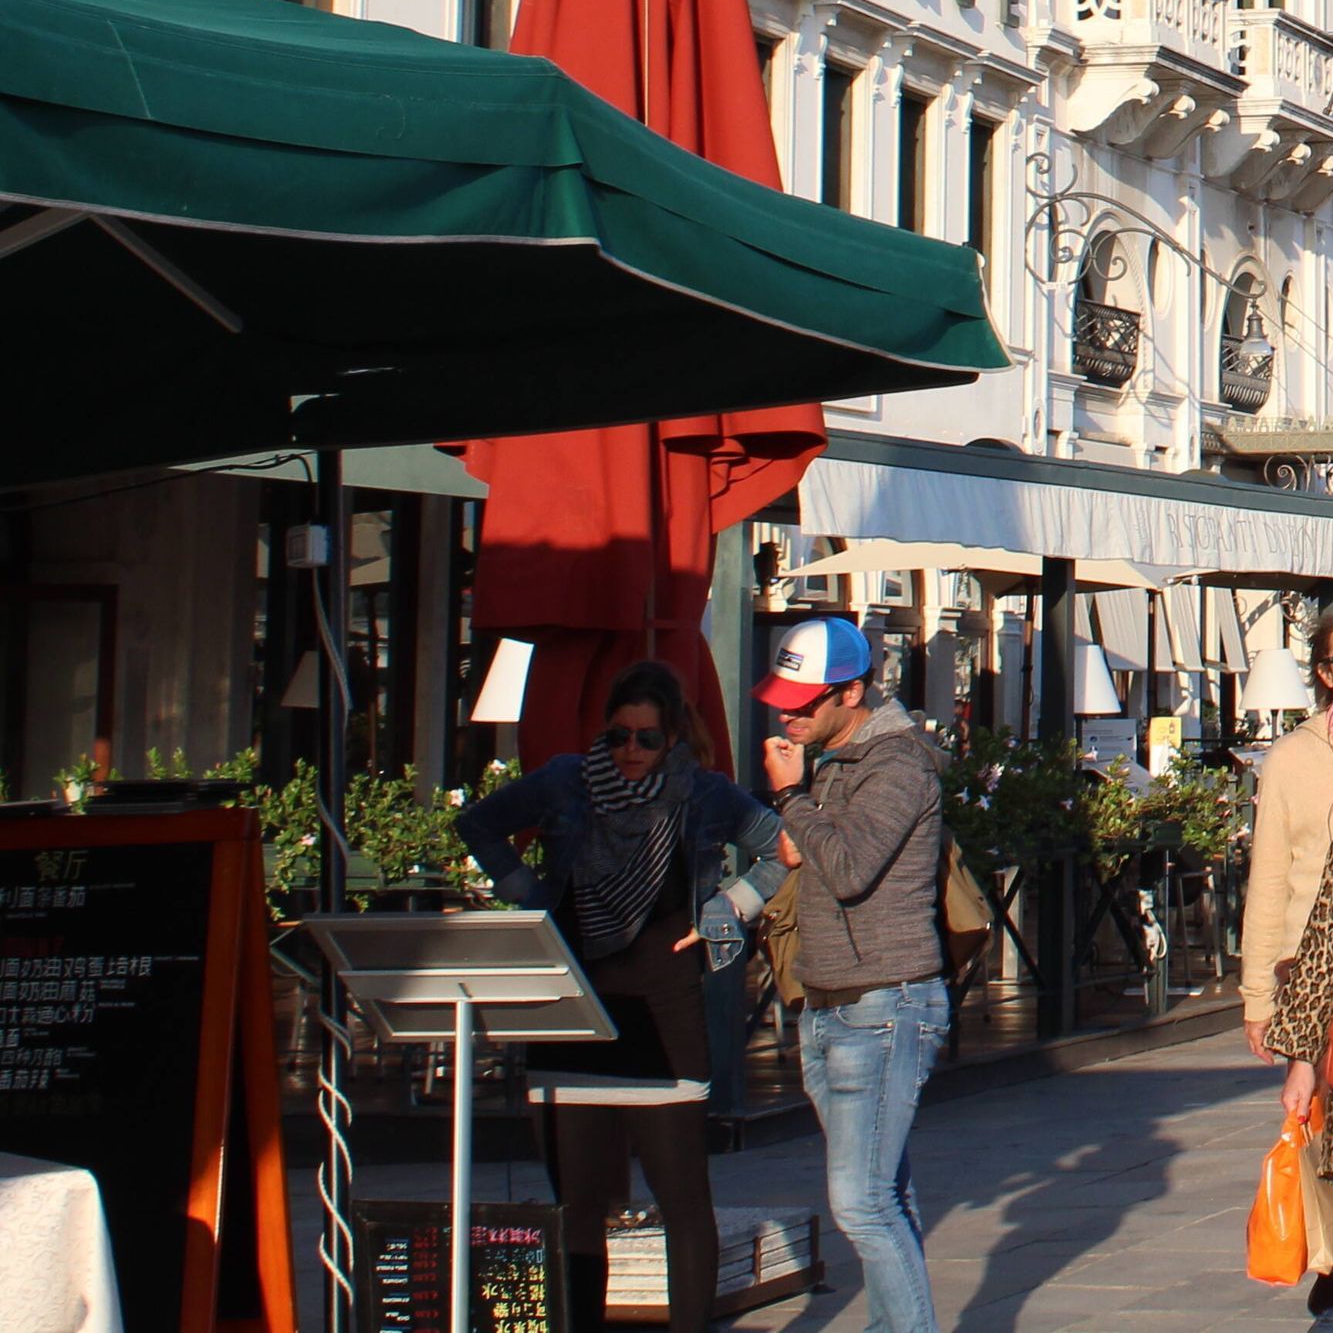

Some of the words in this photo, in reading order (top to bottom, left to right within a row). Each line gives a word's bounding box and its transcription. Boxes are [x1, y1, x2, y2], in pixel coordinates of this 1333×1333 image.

[0, 980, 96, 1002] 面奶油蘑菇
